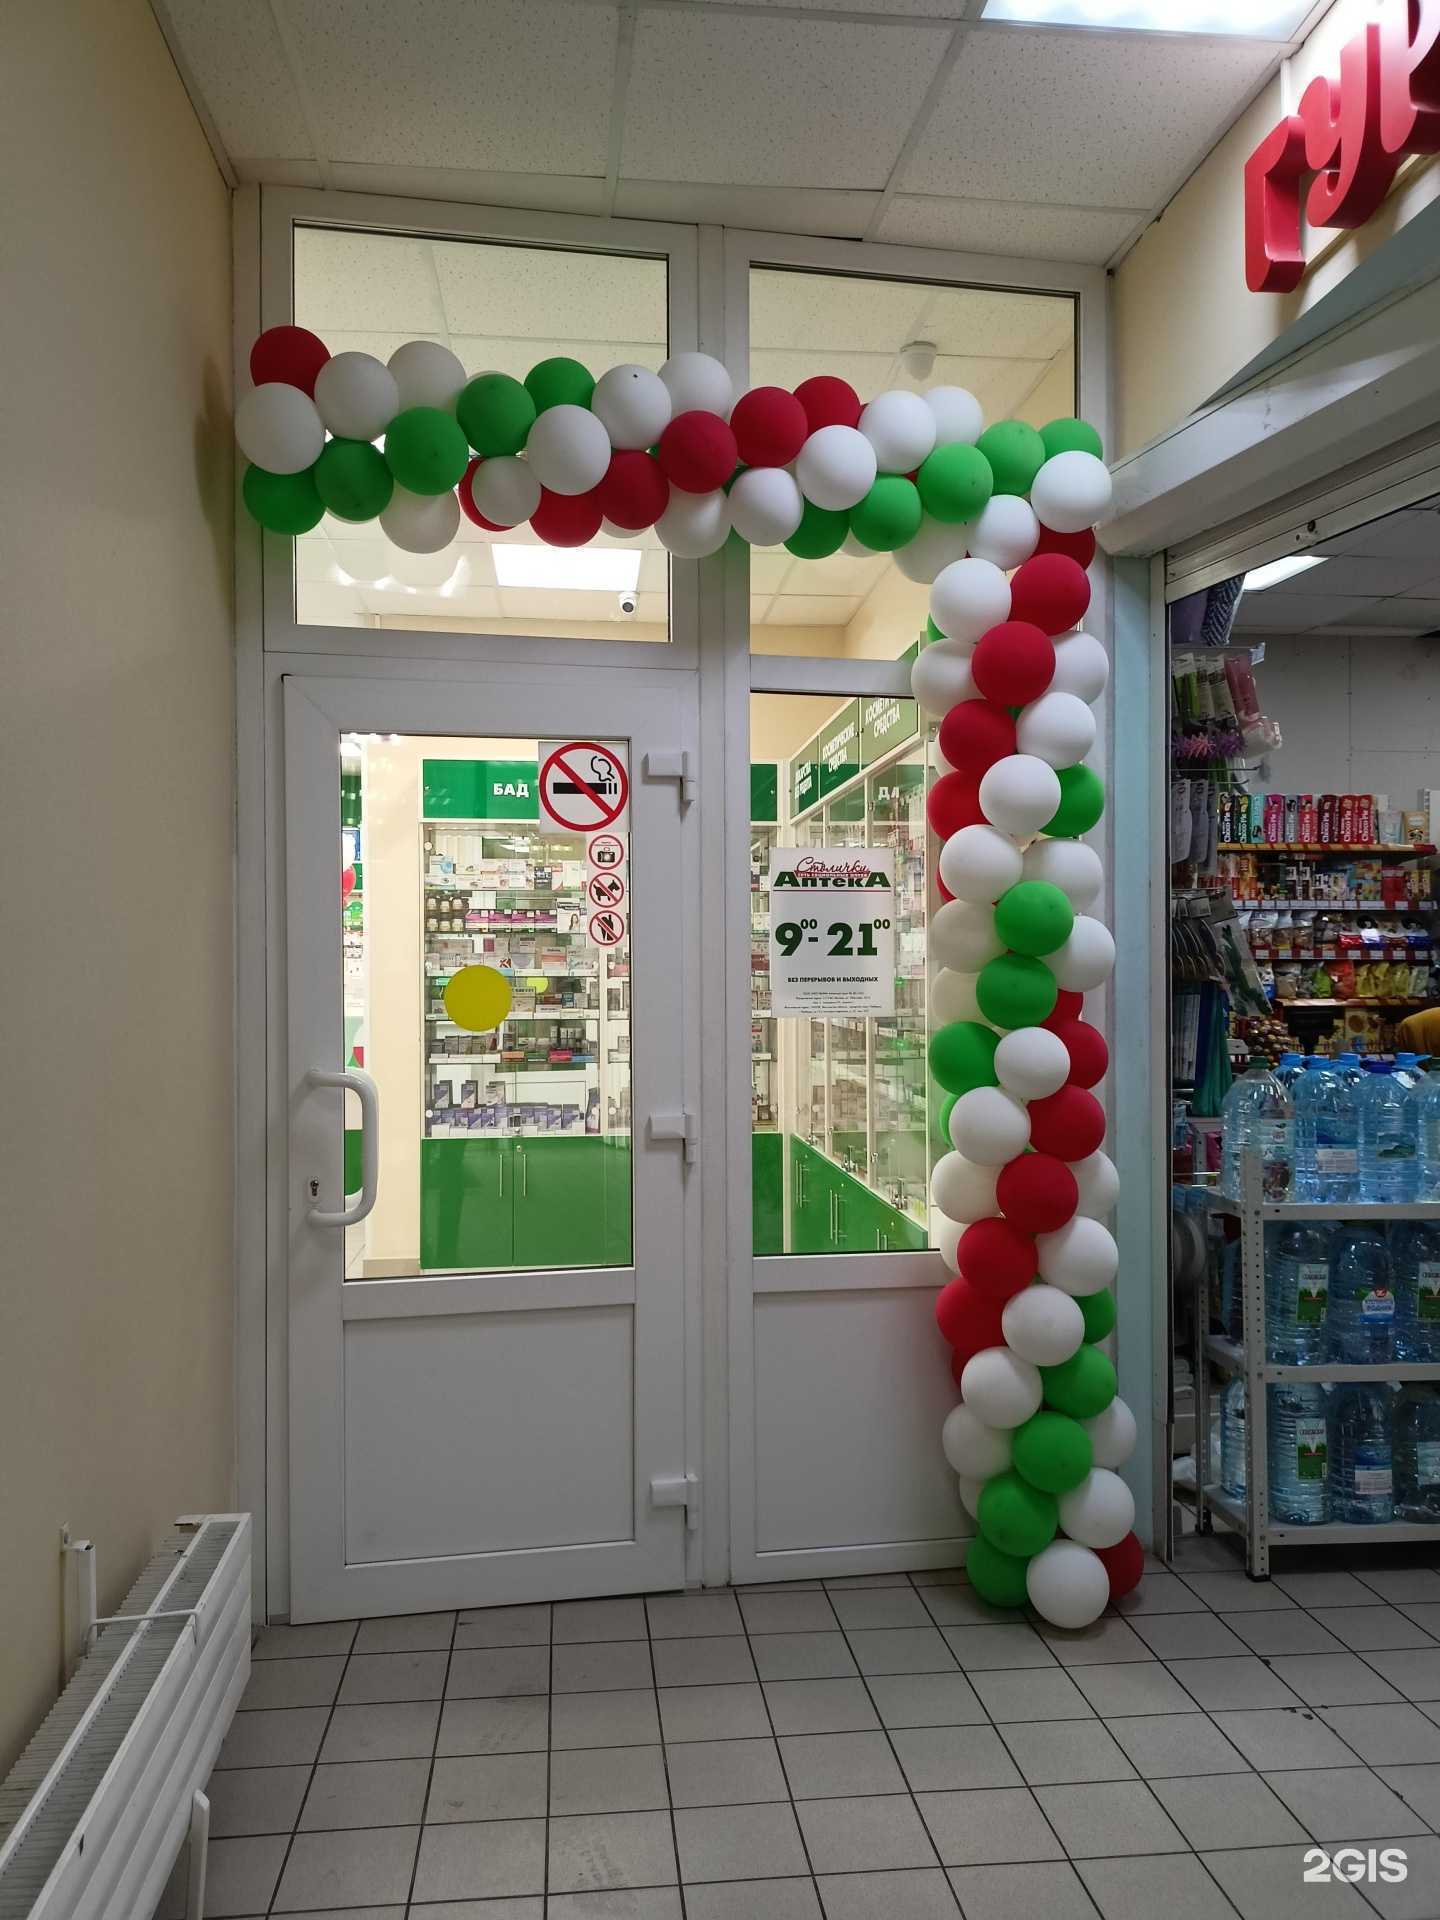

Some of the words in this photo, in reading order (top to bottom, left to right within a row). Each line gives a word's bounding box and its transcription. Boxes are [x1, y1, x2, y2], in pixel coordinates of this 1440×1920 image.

[493, 783, 530, 798] БАД
[1223, 822, 1231, 843] Choco
[796, 856, 869, 874] Столички
